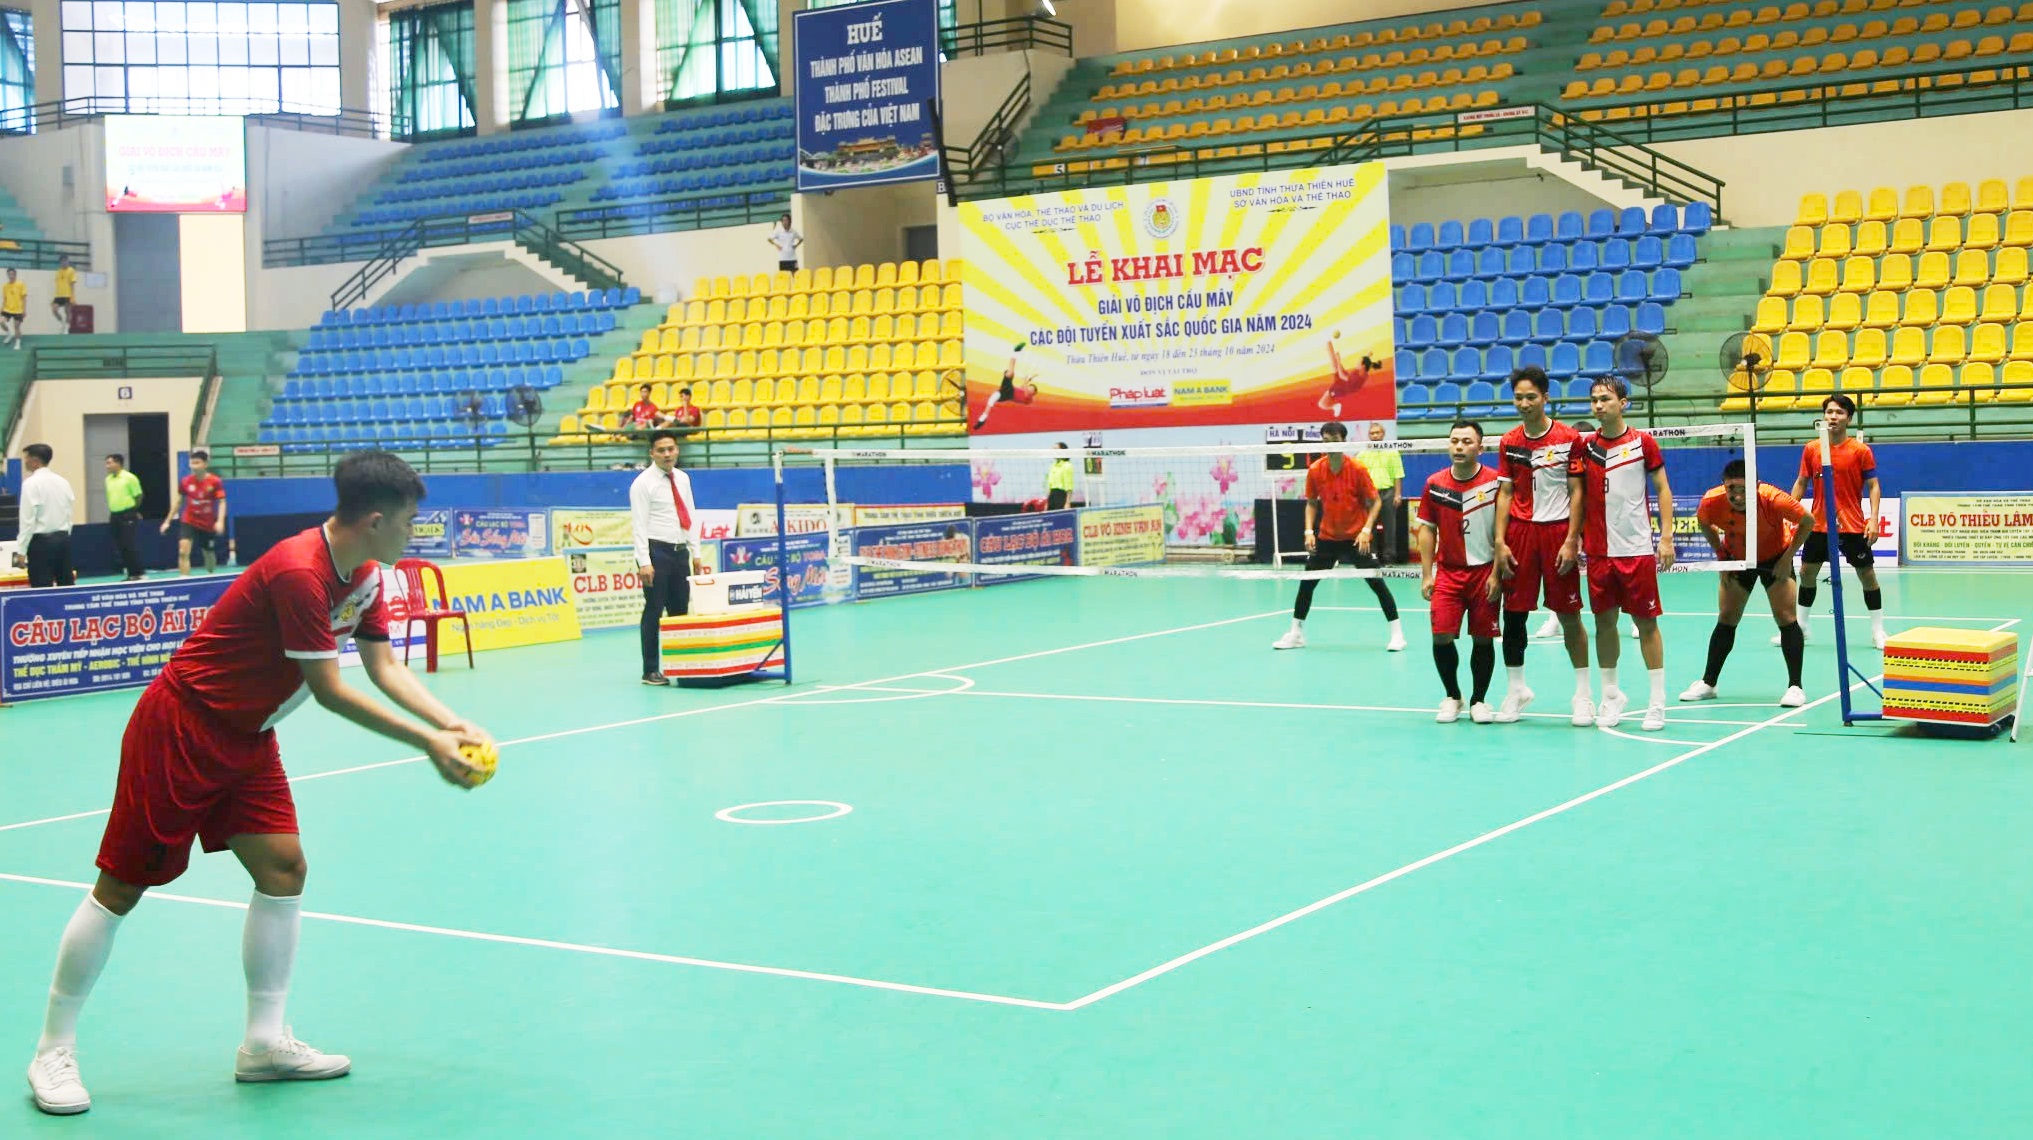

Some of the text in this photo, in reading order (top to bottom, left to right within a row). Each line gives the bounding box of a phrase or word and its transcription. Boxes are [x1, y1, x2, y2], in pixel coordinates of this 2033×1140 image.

[847, 12, 883, 45] HUẾ
[810, 46, 923, 78] THÀNH PHỐ VĂN HÓA ASEAN
[825, 75, 909, 104] THÀNH PHỐ FESTIVAL
[1230, 188, 1254, 198] UBND
[1326, 190, 1351, 199] THAO
[1054, 206, 1076, 215] THAO
[1079, 214, 1101, 223] THAO
[1067, 247, 1264, 285] LỄ KHAI MẠC
[1098, 288, 1234, 315] GIẢI VÔ ĐỊCH CẦU MÂY
[1030, 314, 1312, 347] CÁC ĐỘI TUYỂN XUẤT SẮC QUỐC GIA NĂM 2024
[770, 519, 827, 533] AKIDO
[1462, 519, 1470, 535] 2
[1910, 513, 1936, 527] CLB
[574, 568, 643, 594] CLB BÓ
[1104, 570, 1138, 578] MARATHON
[1382, 571, 1420, 579] MARATHON
[491, 593, 505, 611] A
[508, 587, 567, 609] BANK
[10, 604, 216, 647] CÂU LẠC BỘ ÁI H
